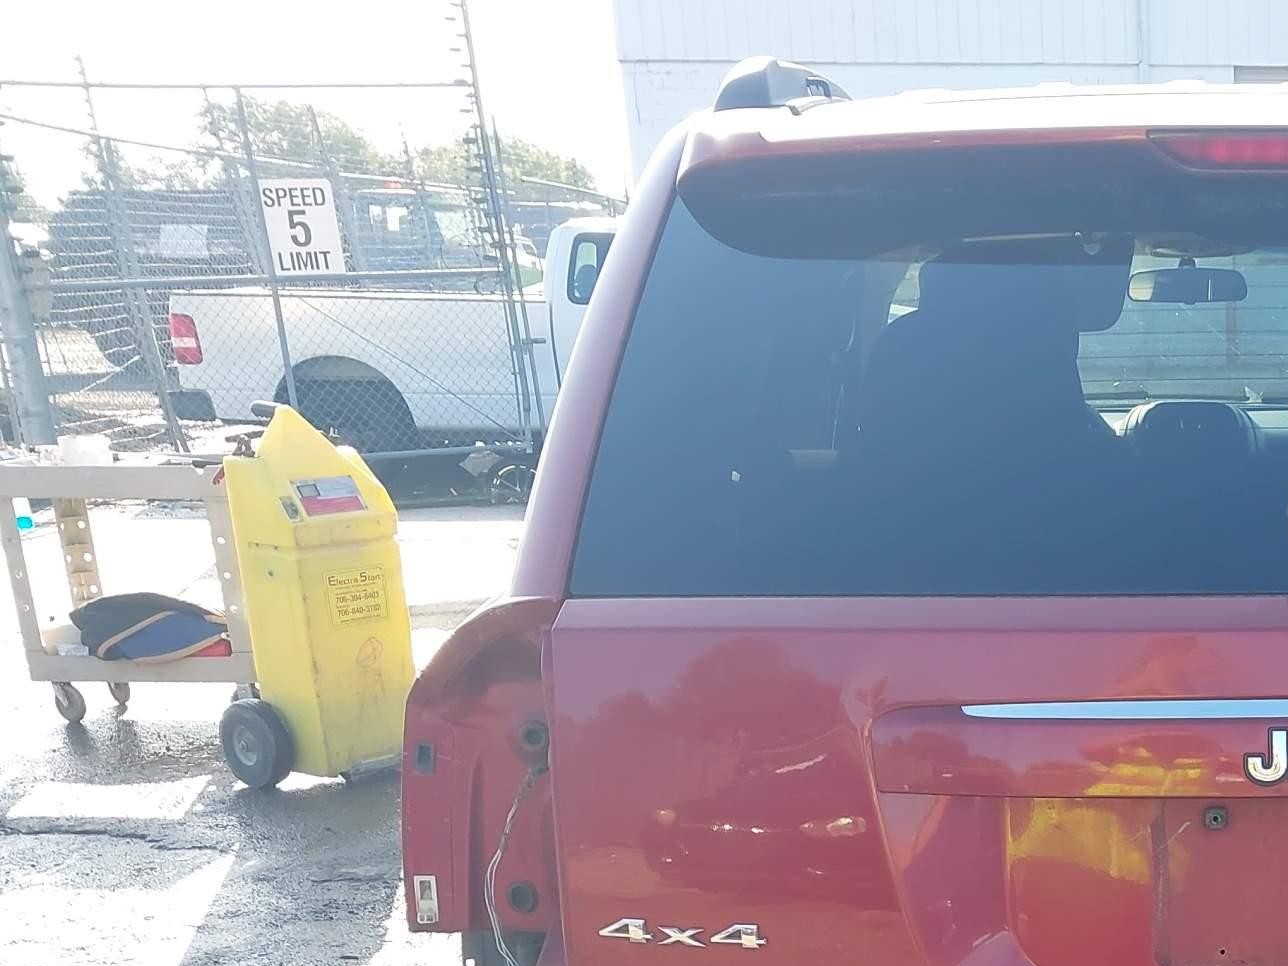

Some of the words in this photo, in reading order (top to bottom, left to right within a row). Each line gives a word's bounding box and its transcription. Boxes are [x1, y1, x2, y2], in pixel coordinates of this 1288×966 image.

[262, 187, 326, 208] SPEED
[287, 209, 312, 247] 5
[278, 250, 331, 271] LIMIT
[598, 917, 768, 949] 4x4
